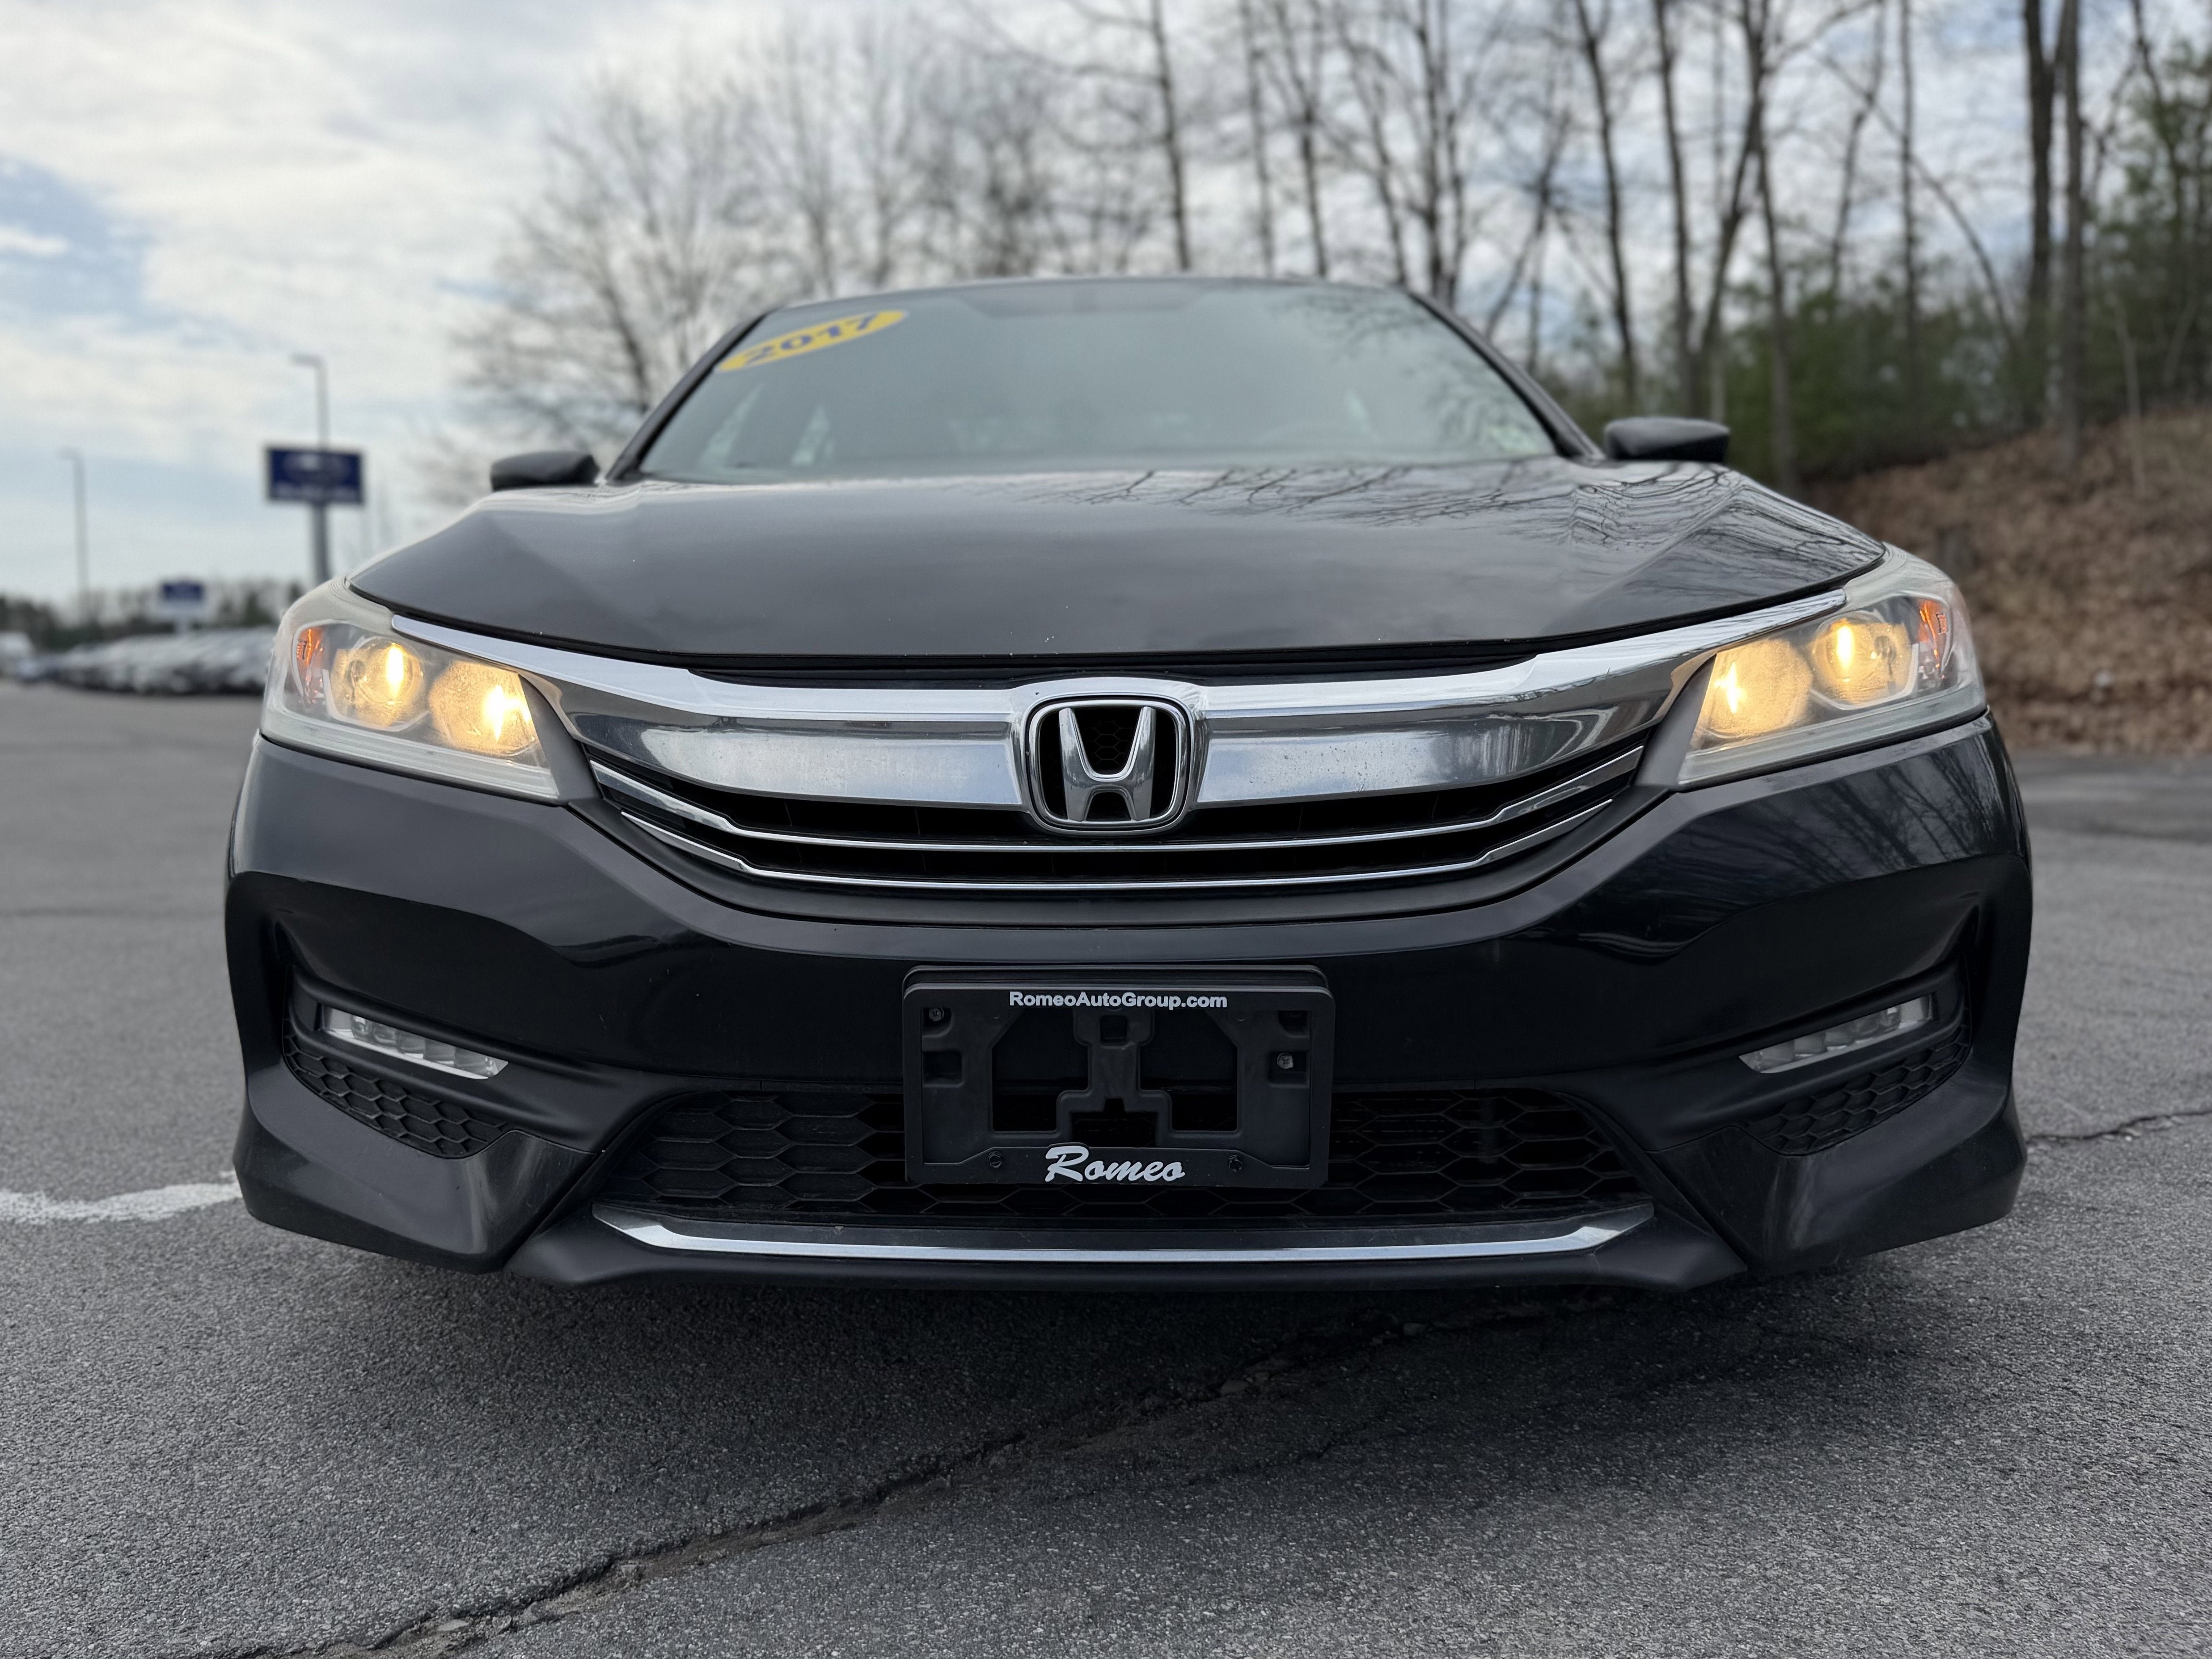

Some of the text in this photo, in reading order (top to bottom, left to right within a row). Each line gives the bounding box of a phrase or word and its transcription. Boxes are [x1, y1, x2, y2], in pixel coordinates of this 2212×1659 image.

[742, 312, 879, 365] 2017
[1009, 991, 1227, 1010] RomeoAutoGroup.com
[1045, 1145, 1185, 1182] Romeo
